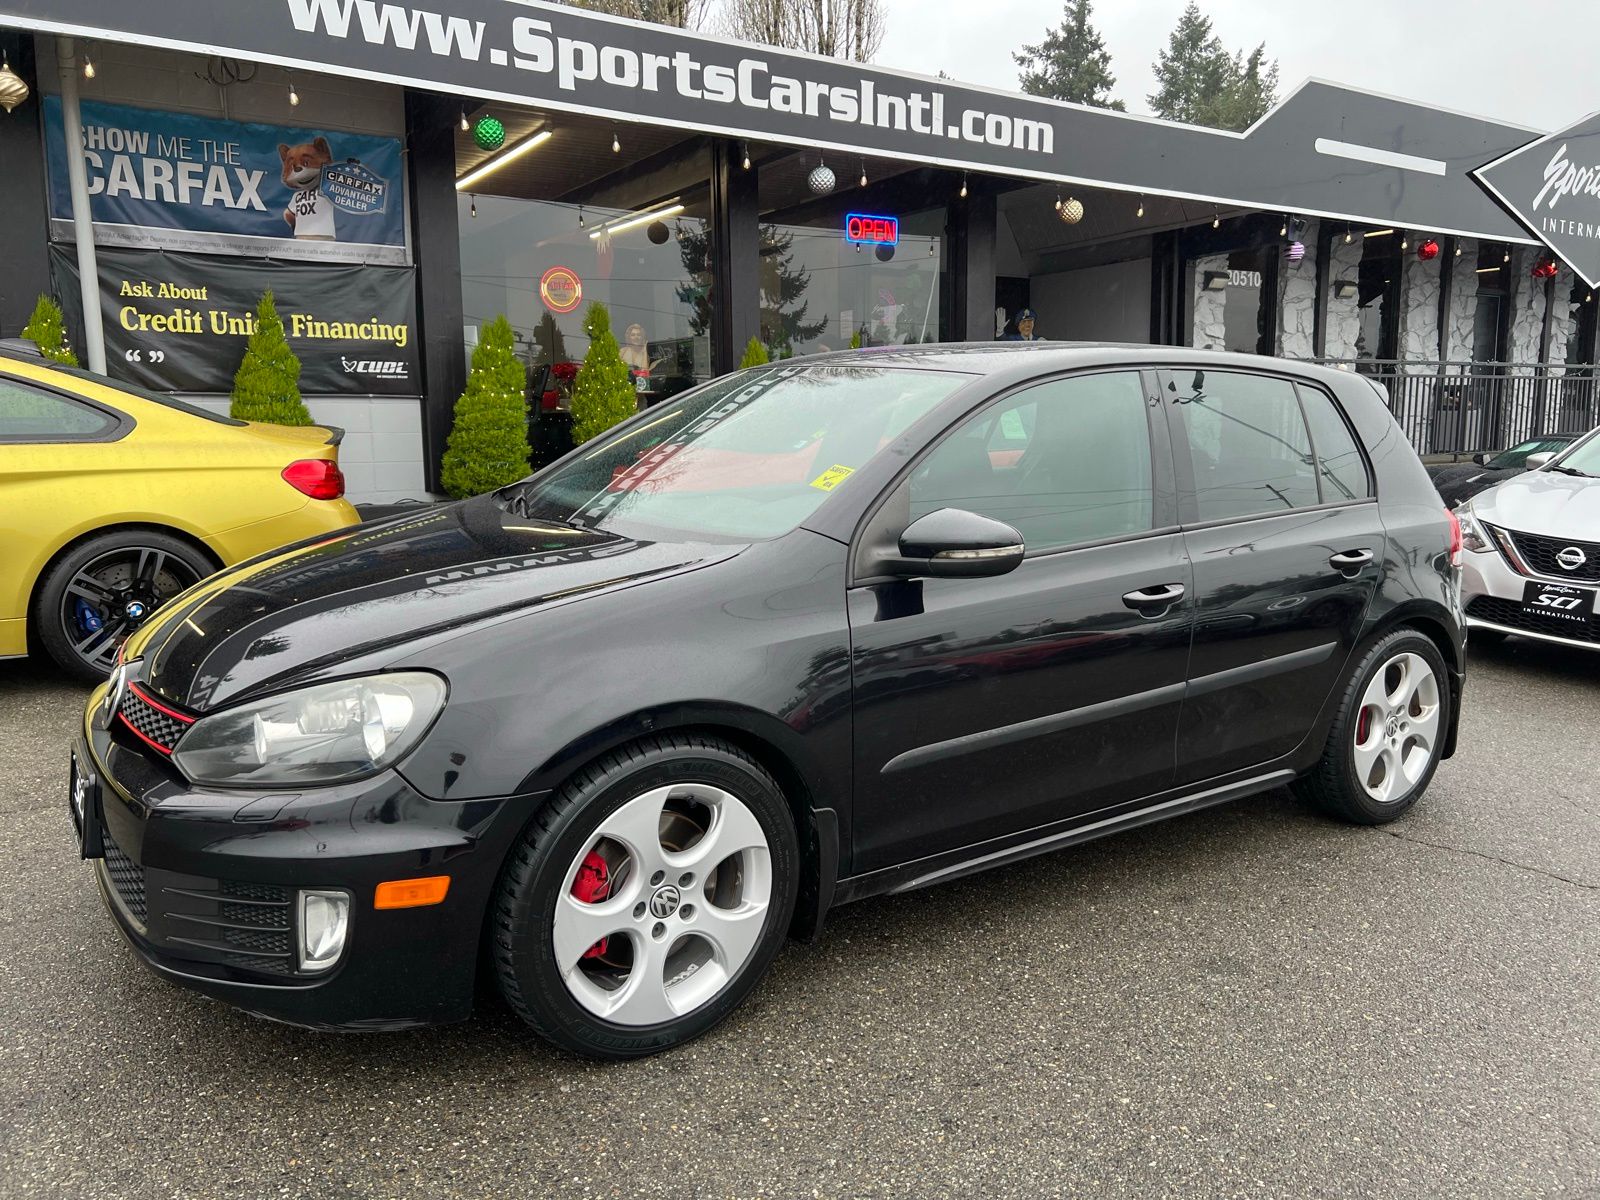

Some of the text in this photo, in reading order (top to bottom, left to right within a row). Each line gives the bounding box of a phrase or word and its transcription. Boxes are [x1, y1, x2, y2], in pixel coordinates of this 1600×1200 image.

[157, 134, 193, 160] ME
[197, 139, 241, 166] THE
[327, 171, 382, 195] CARFAX
[296, 189, 316, 203] CAR
[329, 184, 377, 204] ADVANTAGE
[335, 196, 368, 211] DEALER
[296, 202, 316, 216] FOX
[848, 217, 896, 242] OPEN
[119, 280, 208, 300] Ask About
[119, 306, 408, 347] Credit Uni Financing
[1531, 594, 1583, 610] SCI
[1523, 607, 1586, 622] INTERNATIONAL
